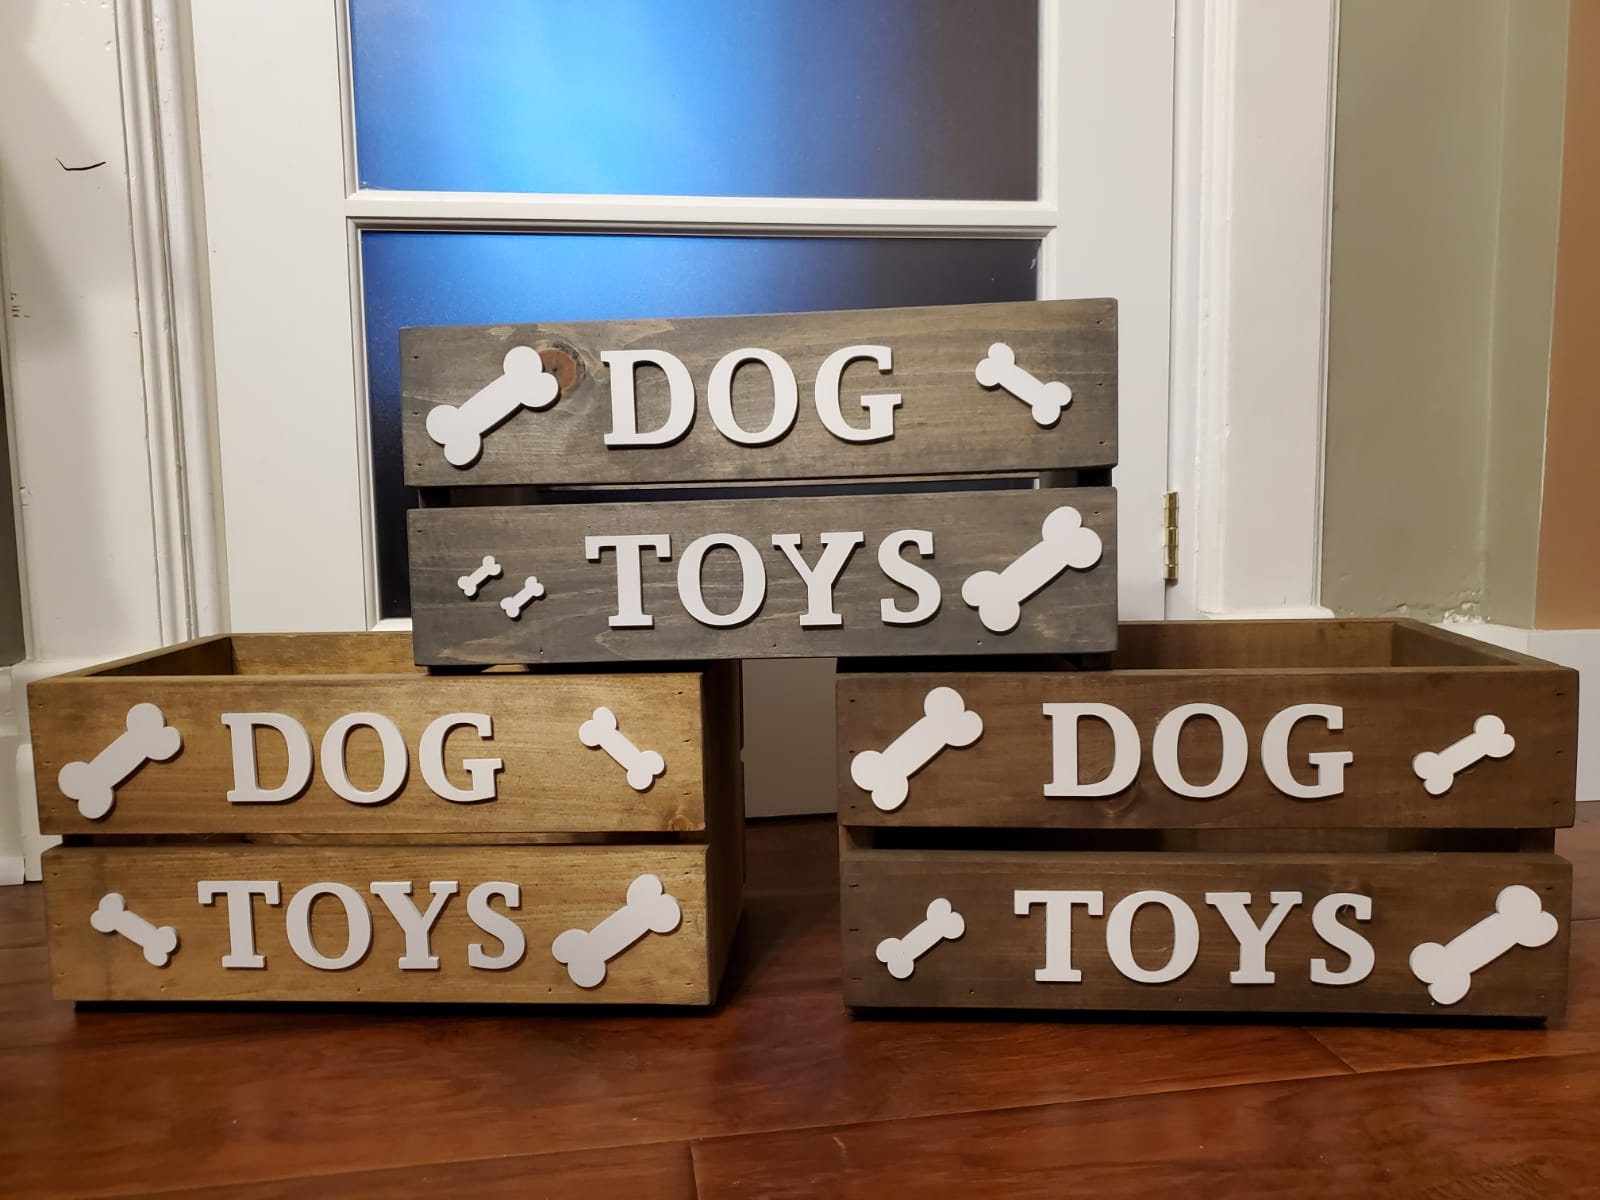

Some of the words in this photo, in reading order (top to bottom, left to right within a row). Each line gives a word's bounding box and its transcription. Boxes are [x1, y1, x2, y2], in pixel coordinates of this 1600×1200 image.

[600, 344, 904, 447] DOG
[584, 529, 942, 629] TOYS
[221, 711, 504, 804] DOG
[1042, 702, 1355, 799] DOG
[197, 880, 526, 971] TOYS
[1013, 889, 1376, 986] TOYS
